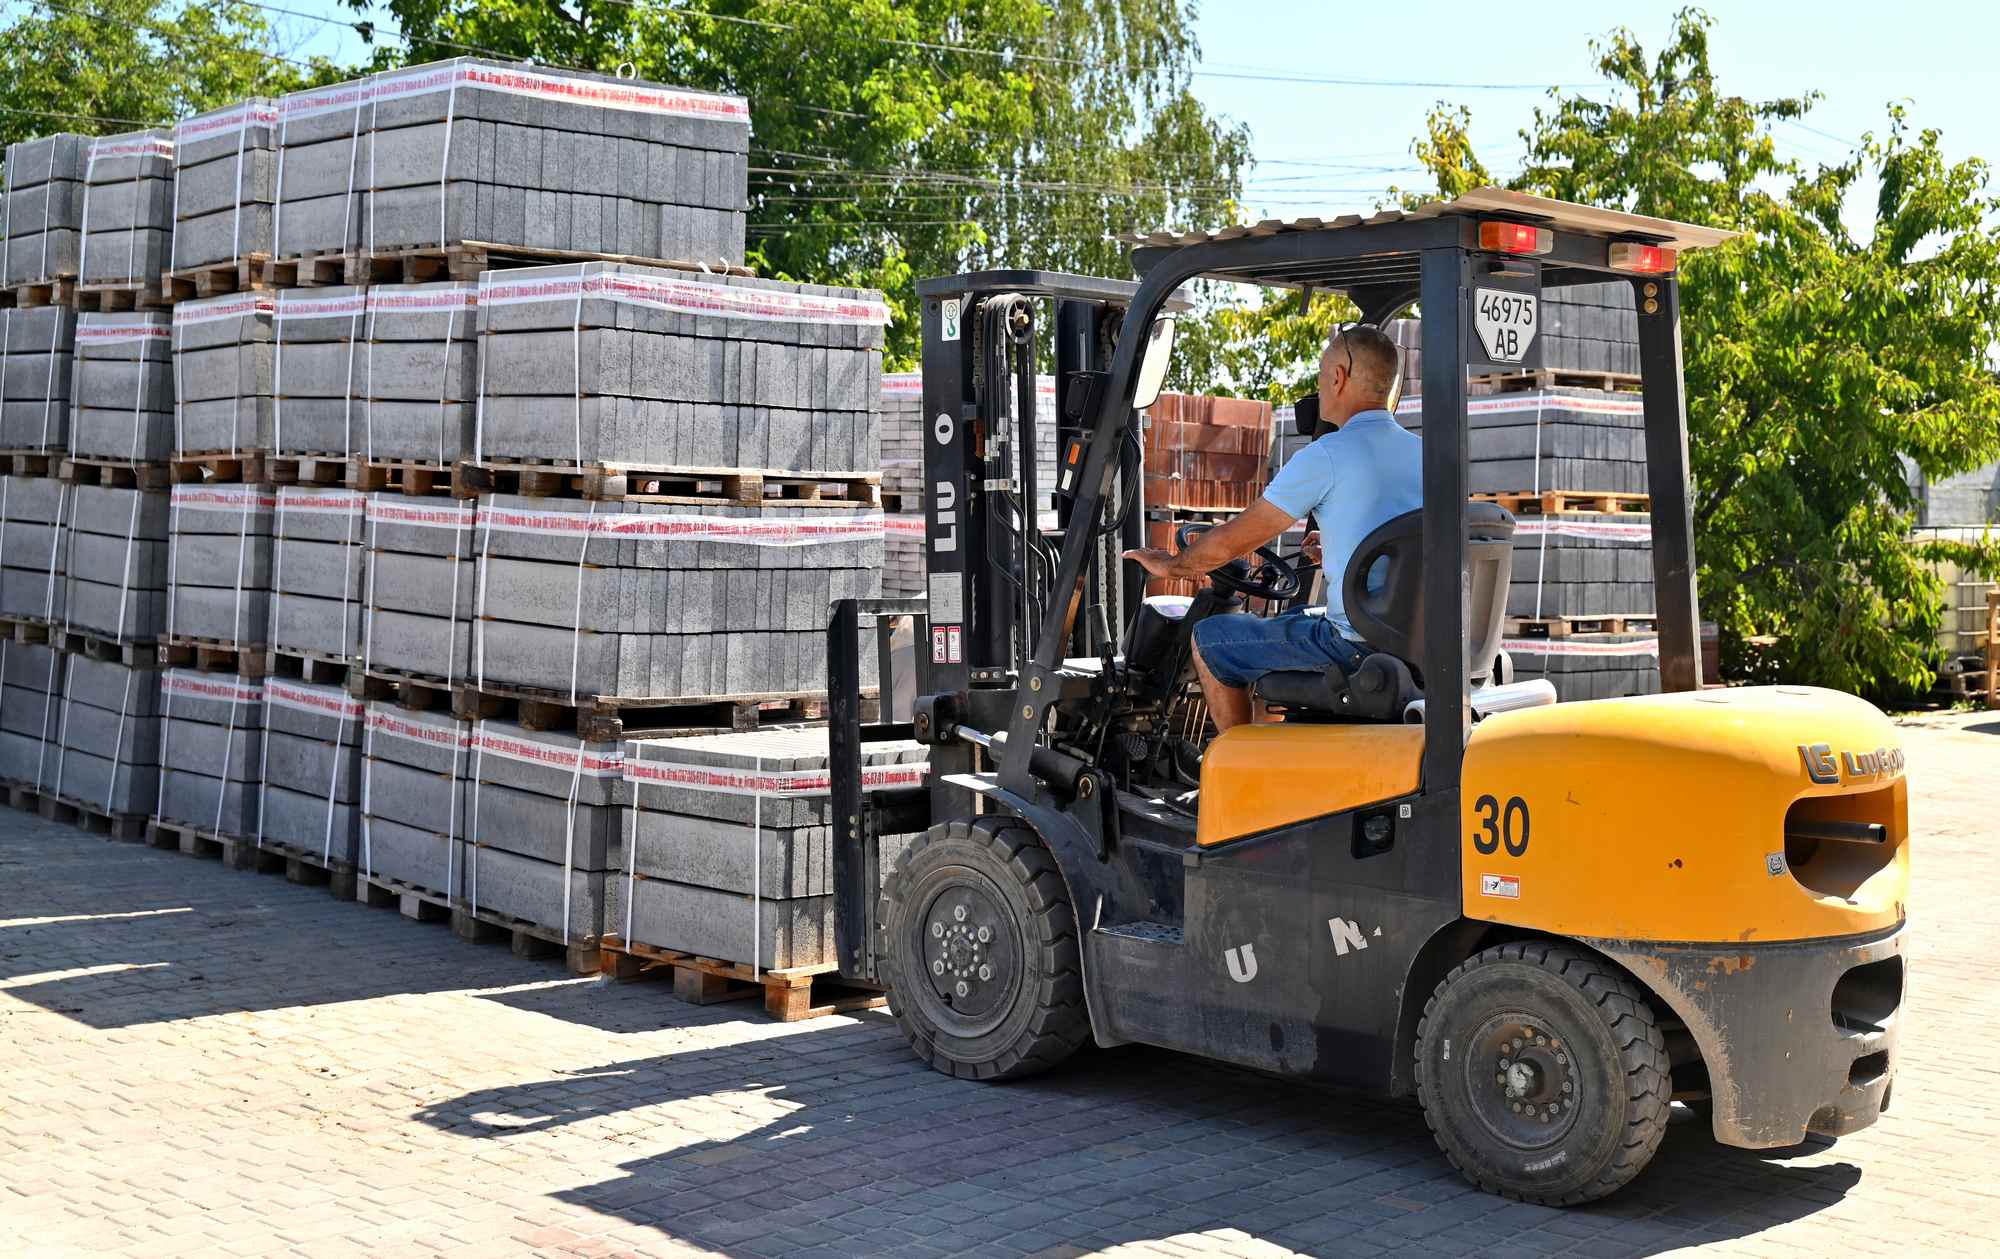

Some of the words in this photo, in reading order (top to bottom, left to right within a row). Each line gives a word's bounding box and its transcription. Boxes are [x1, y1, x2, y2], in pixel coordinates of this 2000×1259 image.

[1480, 294, 1533, 326] 46975
[1495, 329, 1518, 356] AB
[1473, 794, 1530, 857] 30
